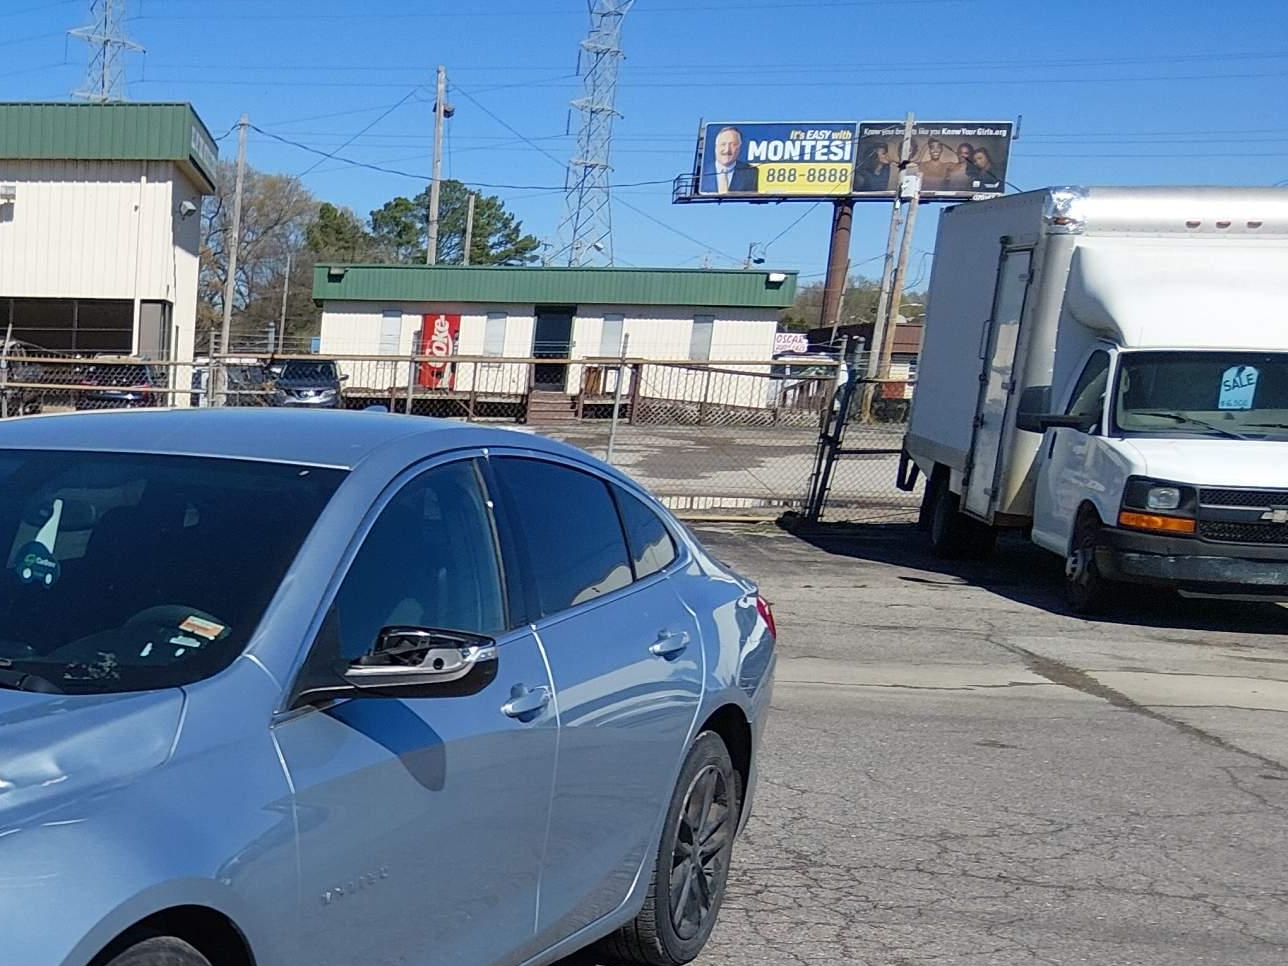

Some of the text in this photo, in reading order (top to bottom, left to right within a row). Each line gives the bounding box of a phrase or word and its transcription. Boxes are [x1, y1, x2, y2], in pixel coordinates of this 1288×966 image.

[806, 129, 832, 140] EASY
[831, 129, 852, 140] with
[747, 140, 852, 161] MONTESI
[766, 168, 849, 183] 888-8888
[1223, 372, 1256, 392] SALE
